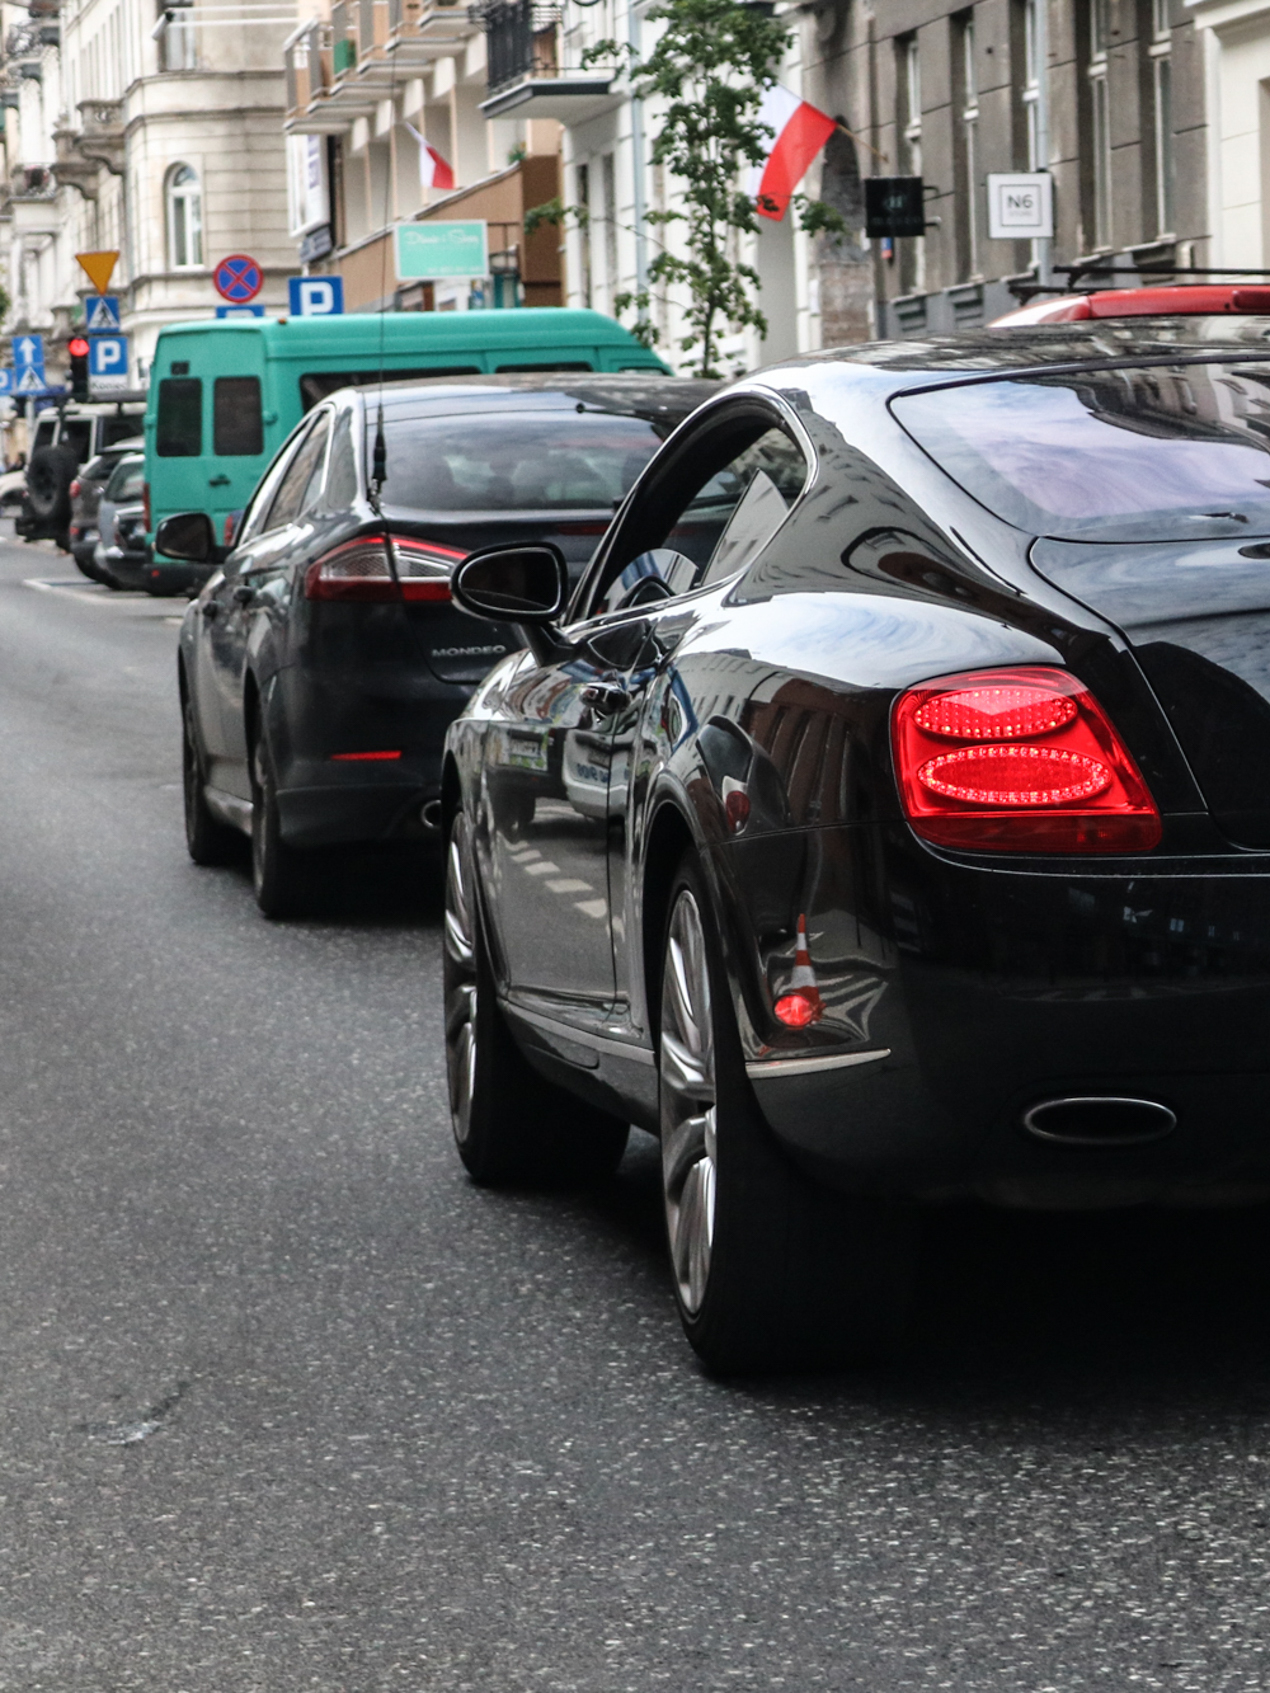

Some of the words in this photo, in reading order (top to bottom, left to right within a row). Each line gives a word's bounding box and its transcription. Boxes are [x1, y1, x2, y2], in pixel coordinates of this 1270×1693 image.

[1007, 194, 1034, 209] N6
[300, 281, 334, 315] P
[97, 340, 121, 372] P
[431, 644, 507, 657] MONDEO
